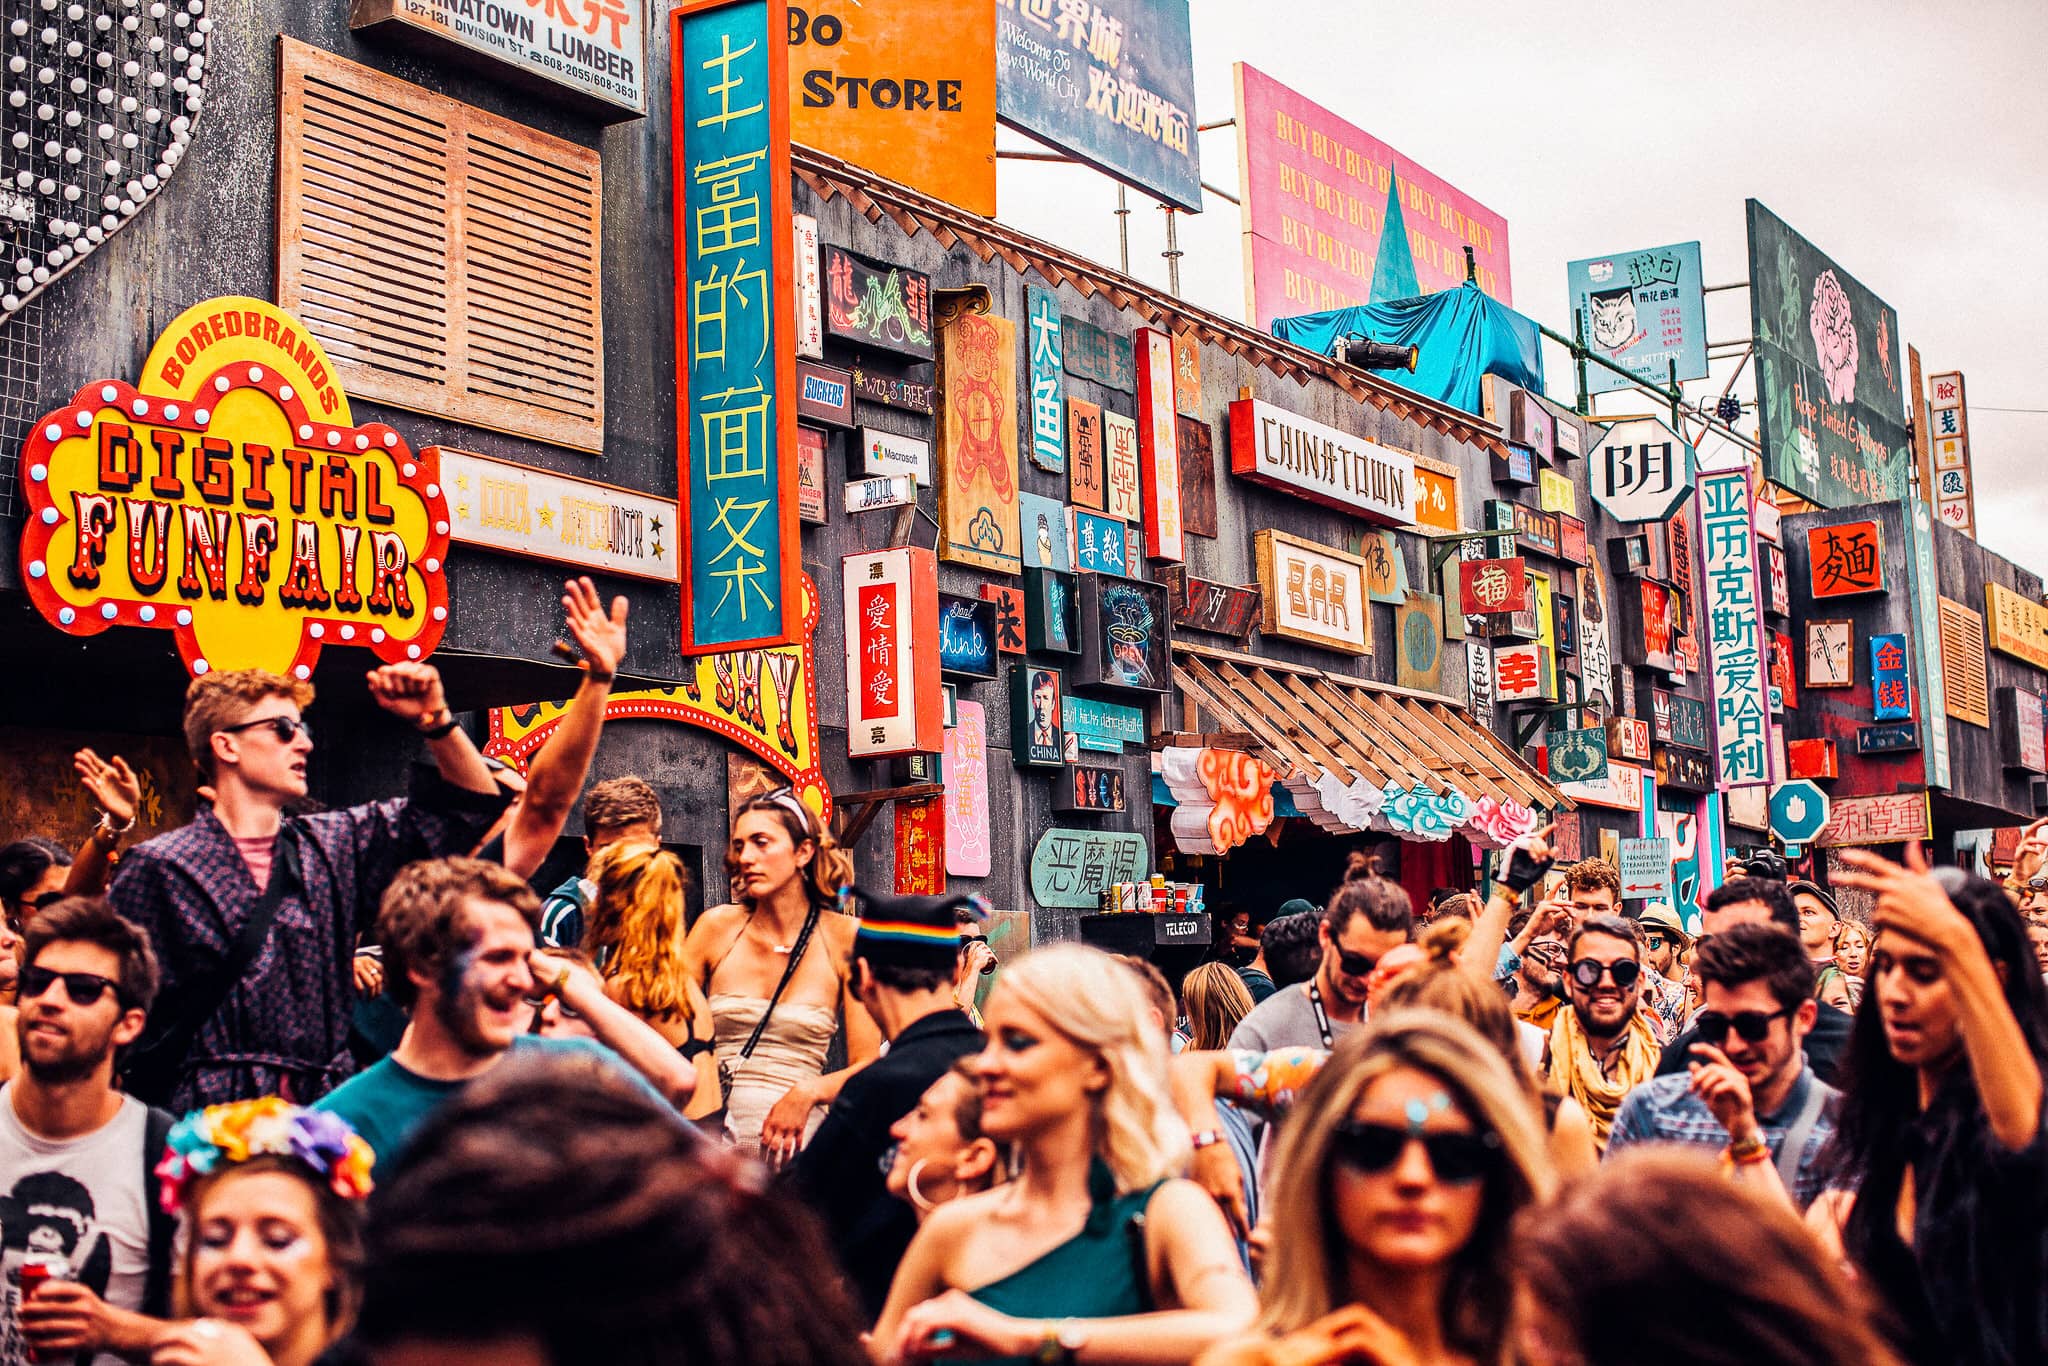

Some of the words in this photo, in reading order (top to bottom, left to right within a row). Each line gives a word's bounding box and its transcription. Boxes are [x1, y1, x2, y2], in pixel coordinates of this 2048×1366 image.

[404, 2, 450, 26] 127-131
[455, 20, 505, 50] DIVISION
[508, 38, 527, 58] ST.
[548, 28, 634, 84] LUMBER
[1002, 21, 1051, 61] Welcome
[1053, 49, 1071, 72] To
[803, 70, 962, 113] STORE
[1021, 54, 1056, 88] World
[1057, 76, 1080, 109] City
[1276, 110, 1308, 151] BUY
[1312, 129, 1342, 169] BUY
[1345, 148, 1374, 187] BUY
[1409, 183, 1435, 221] BUY
[1440, 201, 1465, 239] BUY
[1467, 217, 1492, 254] BUY
[1279, 161, 1311, 206] BUY
[1315, 178, 1345, 221] BUY
[1348, 196, 1377, 236] BUY
[1413, 230, 1439, 268] BUY
[1281, 215, 1313, 256] BUY
[1317, 232, 1348, 272] BUY
[1284, 268, 1316, 310] BUY
[159, 310, 339, 416] BOREDBRANDS
[1032, 300, 1062, 458] 大鱼
[804, 377, 844, 407] SUCKERS
[889, 380, 933, 408] STREET
[1794, 383, 1817, 422] Rose
[1819, 398, 1846, 439] Tinted
[1849, 416, 1886, 466] Eyedrops
[98, 421, 395, 524] DIGITAL
[884, 448, 918, 464] Macrosoft
[1262, 415, 1406, 511] CHINATOWN
[799, 487, 821, 498] ANGER
[68, 491, 415, 620] FUNFAIR
[1080, 518, 1125, 567] 尊敬
[1287, 557, 1350, 632] BAR
[866, 594, 893, 706] 愛情愛
[940, 615, 987, 657] think
[1704, 474, 1765, 781] 亚历克斯爱哈利
[1875, 642, 1906, 708] 金钱
[714, 650, 799, 760] SHY
[1030, 745, 1060, 761] CHINA
